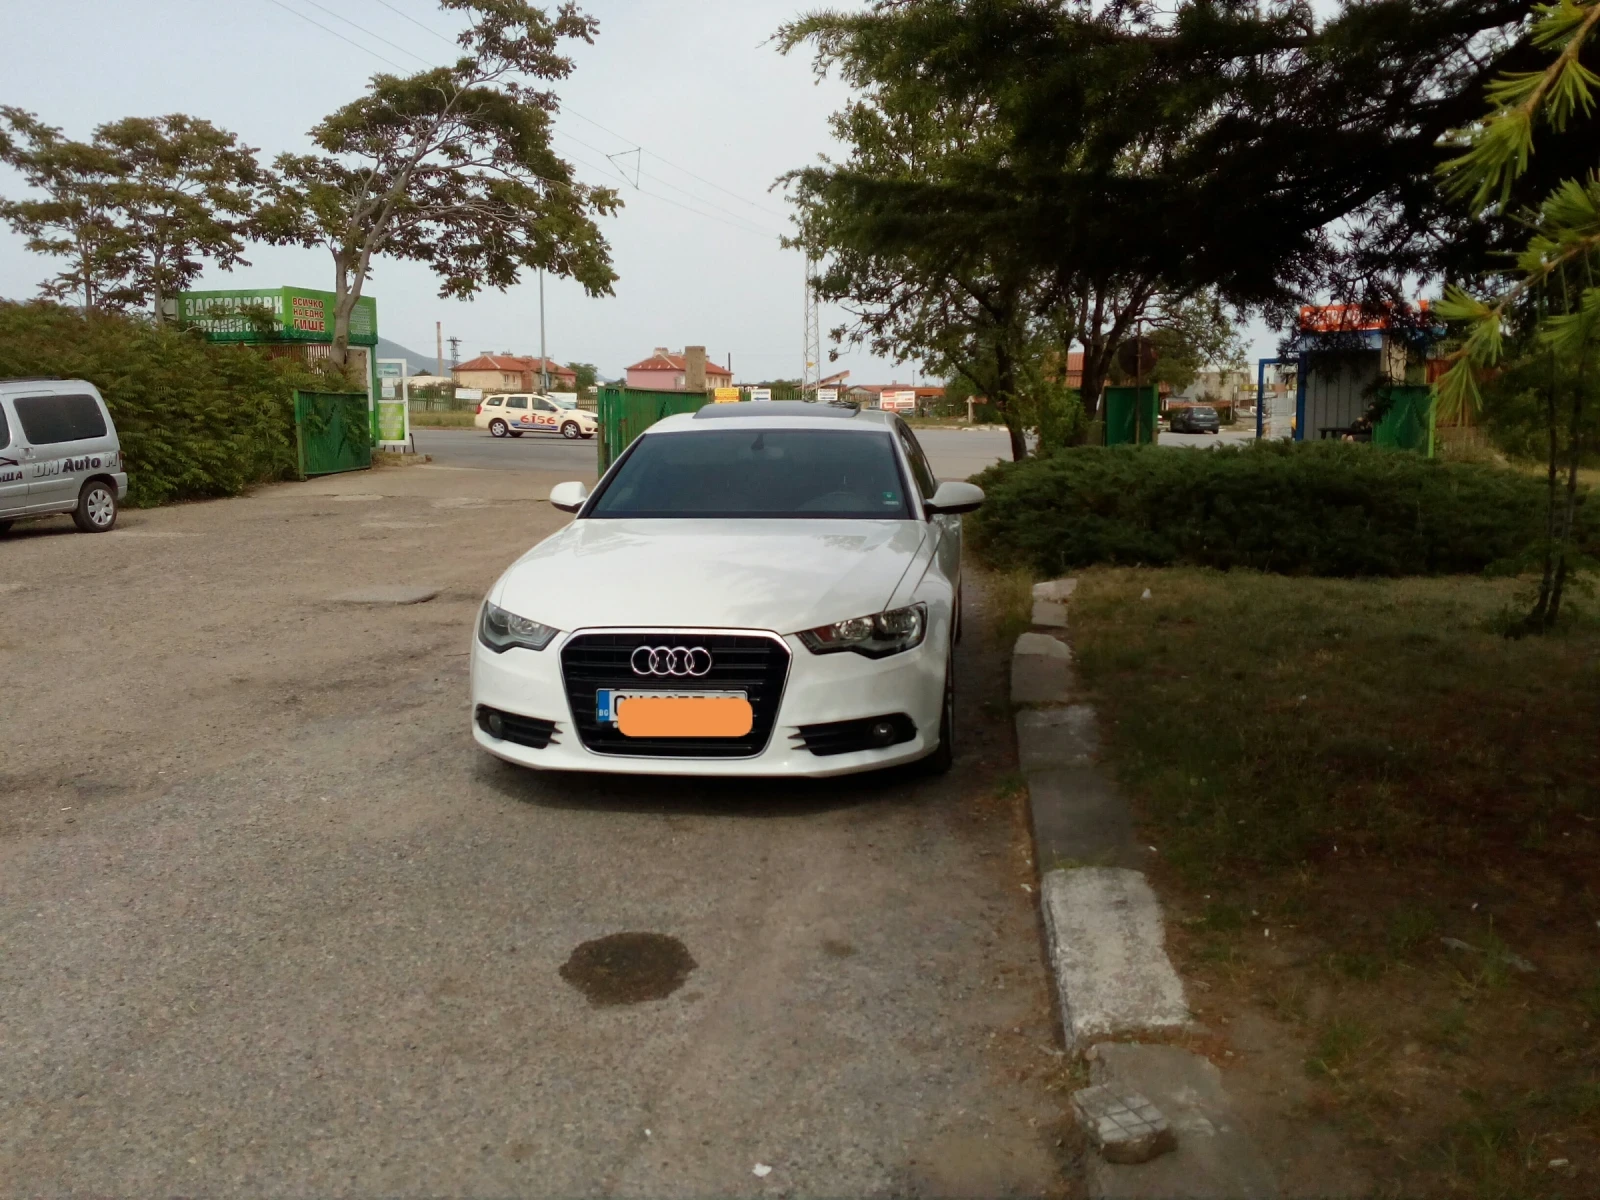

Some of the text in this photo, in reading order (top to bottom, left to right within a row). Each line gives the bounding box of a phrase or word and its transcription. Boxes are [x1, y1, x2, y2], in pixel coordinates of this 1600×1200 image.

[292, 297, 324, 309] ВСИЧКО
[293, 308, 324, 318] НА ЕДНО
[293, 318, 325, 332] ГИШЕ
[520, 415, 556, 425] 6156
[62, 456, 101, 473] Auto
[599, 709, 609, 717] BG
